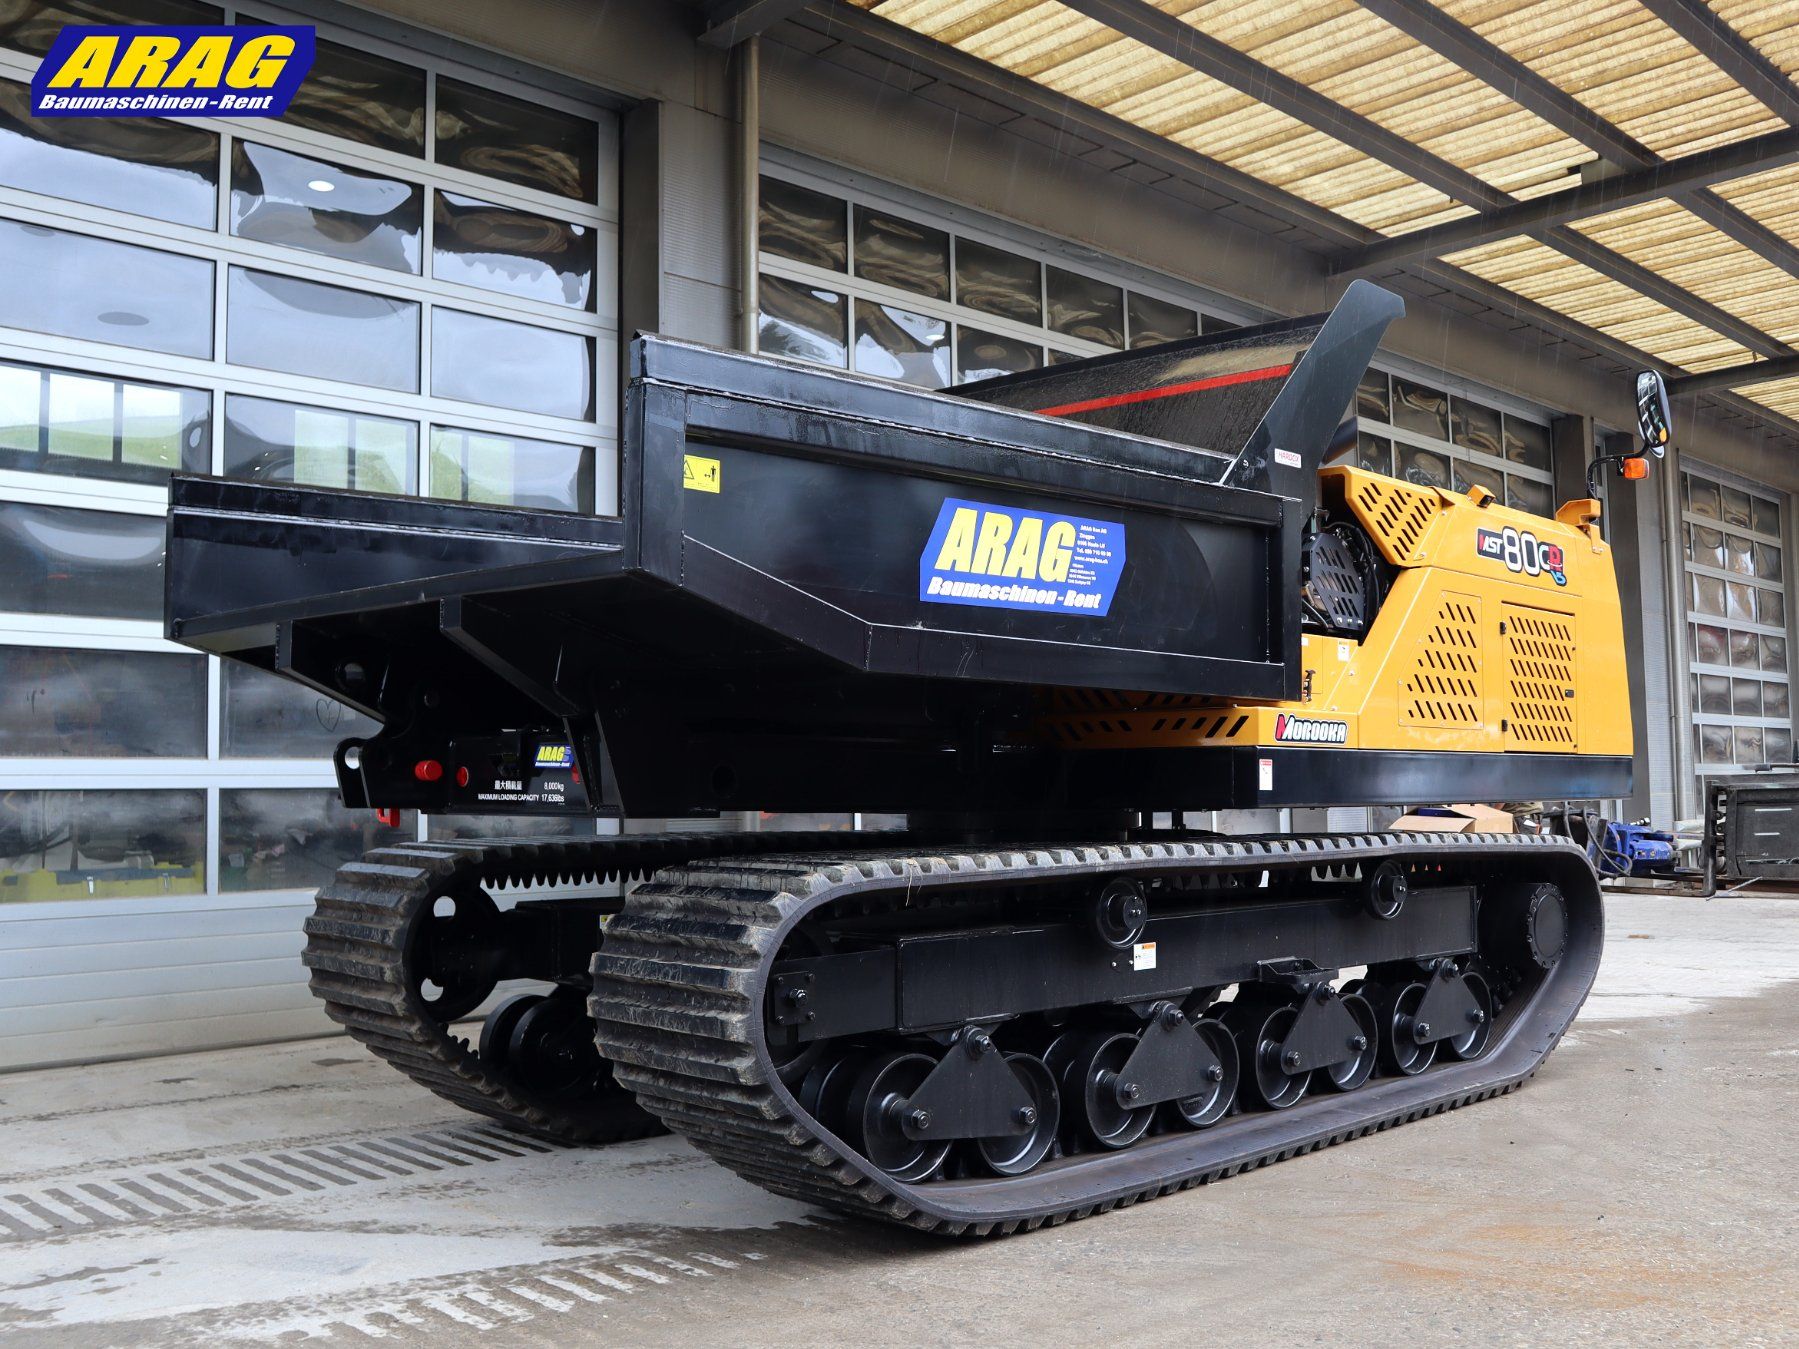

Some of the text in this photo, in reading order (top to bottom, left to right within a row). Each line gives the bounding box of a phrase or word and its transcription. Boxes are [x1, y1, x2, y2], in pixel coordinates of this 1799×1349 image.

[934, 507, 1076, 582] ARAG
[927, 576, 1101, 609] Baumaschinen-Rent
[1276, 714, 1346, 743] MOROOKA
[537, 746, 565, 761] ARAG
[544, 782, 564, 791] 8,000kg
